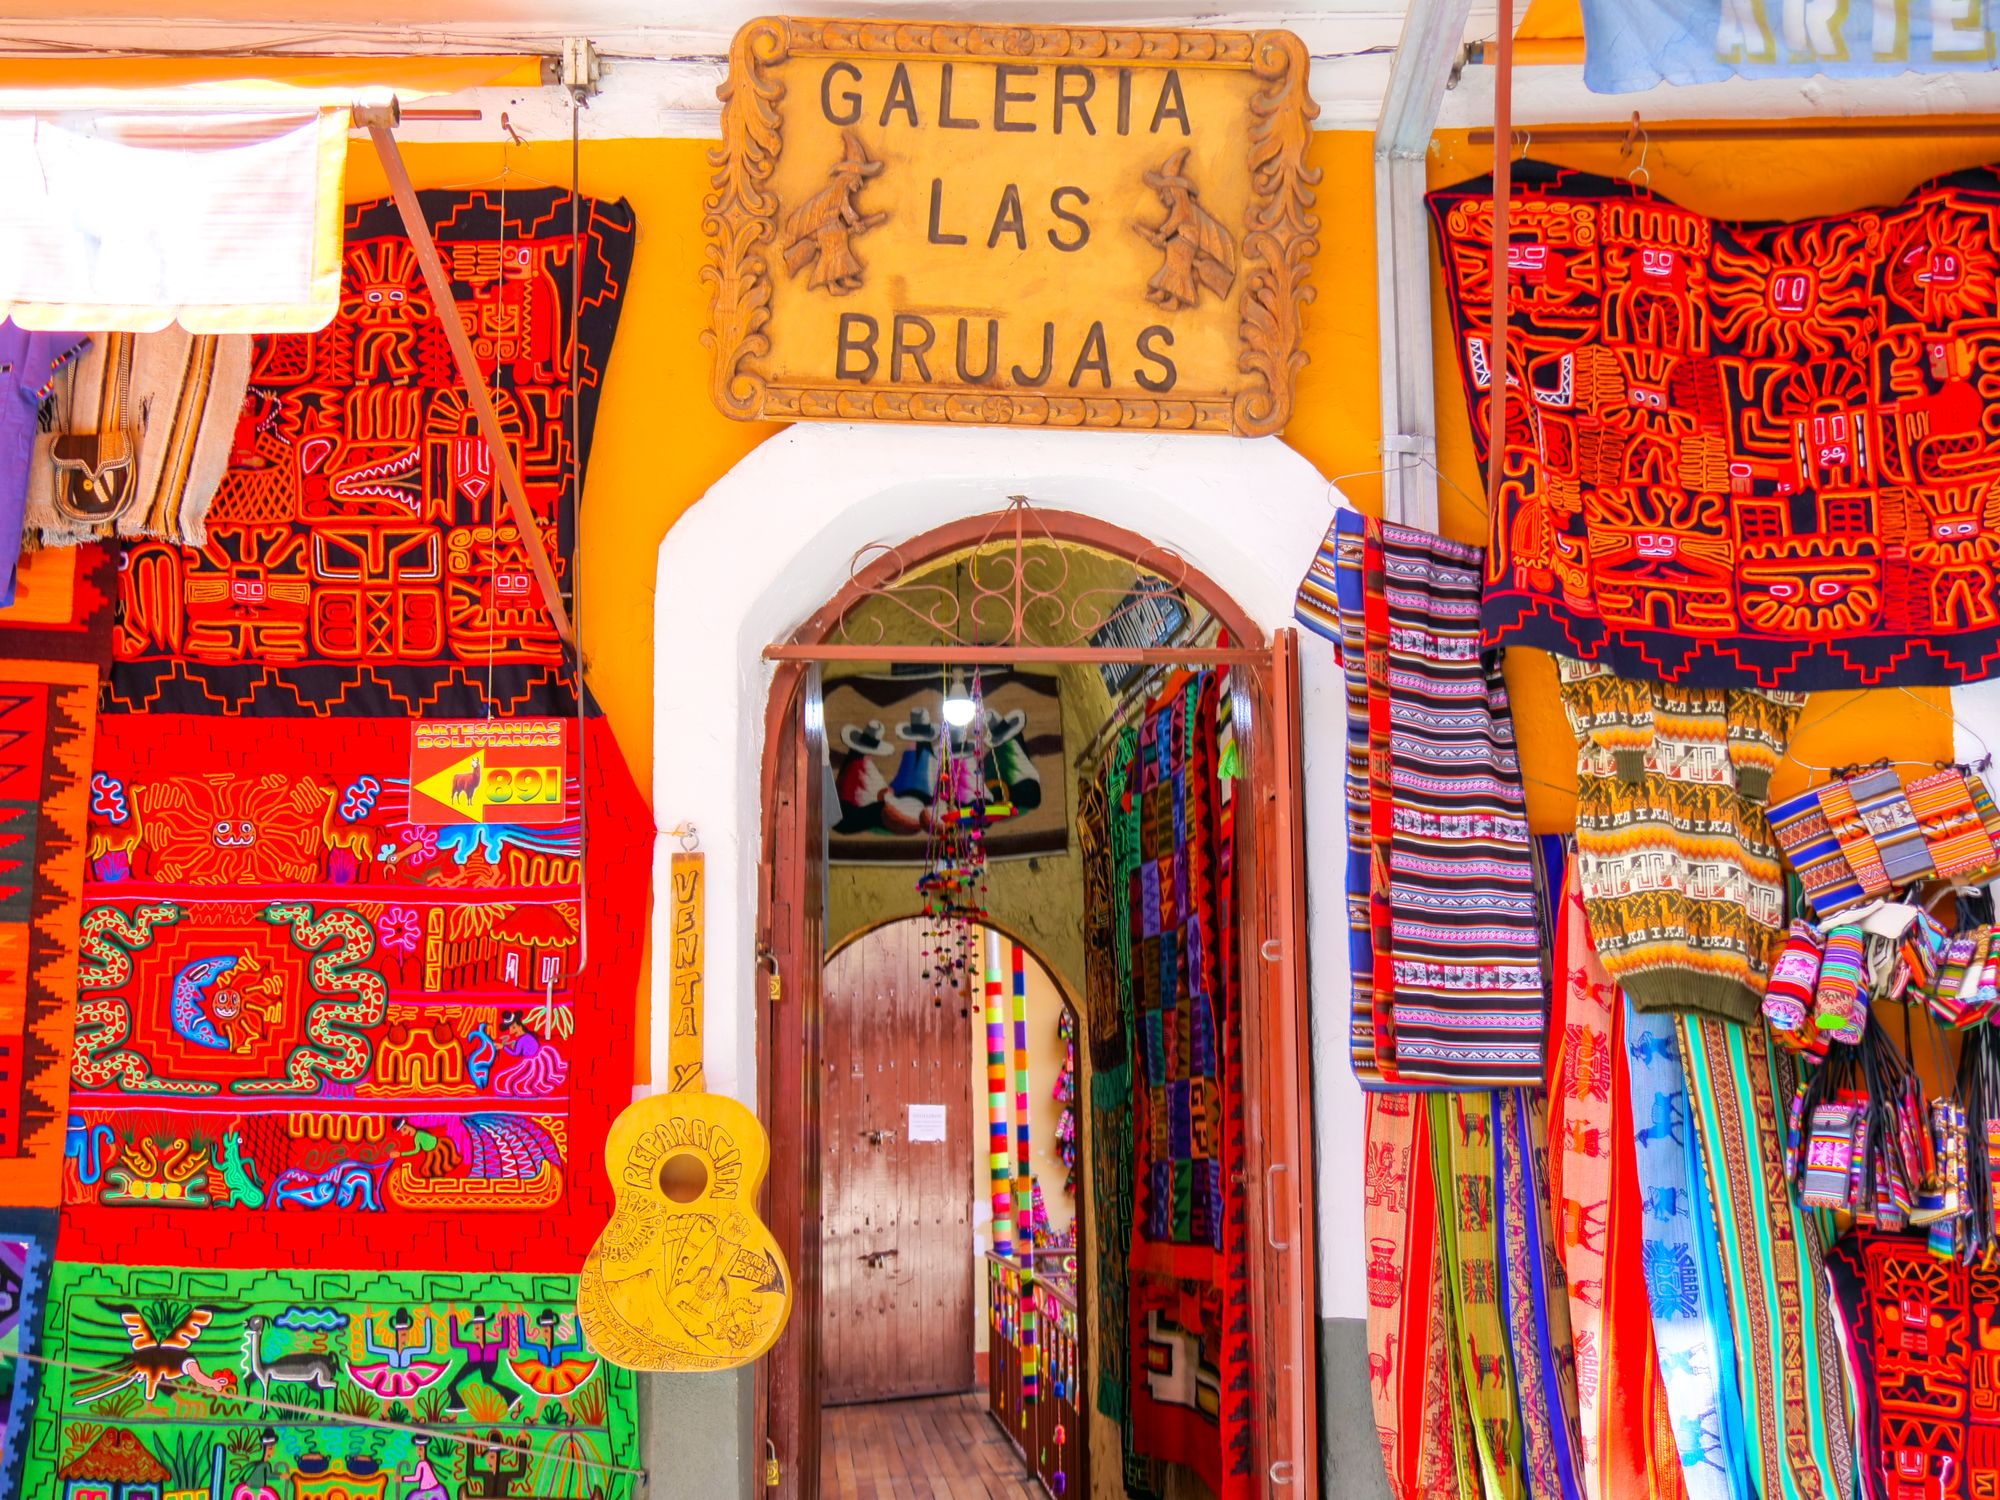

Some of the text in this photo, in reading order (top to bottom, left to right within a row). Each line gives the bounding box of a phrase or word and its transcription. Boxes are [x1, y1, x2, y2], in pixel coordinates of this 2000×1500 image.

[820, 61, 1192, 136] GALERIA
[927, 178, 1092, 252] LAS
[835, 312, 1178, 393] BRUJAS
[415, 722, 561, 736] ARTESANIAS
[417, 735, 561, 749] BOLIVIANAS
[485, 768, 559, 803] 891
[672, 870, 703, 1093] VENTA Y
[622, 1116, 743, 1201] REPARACION
